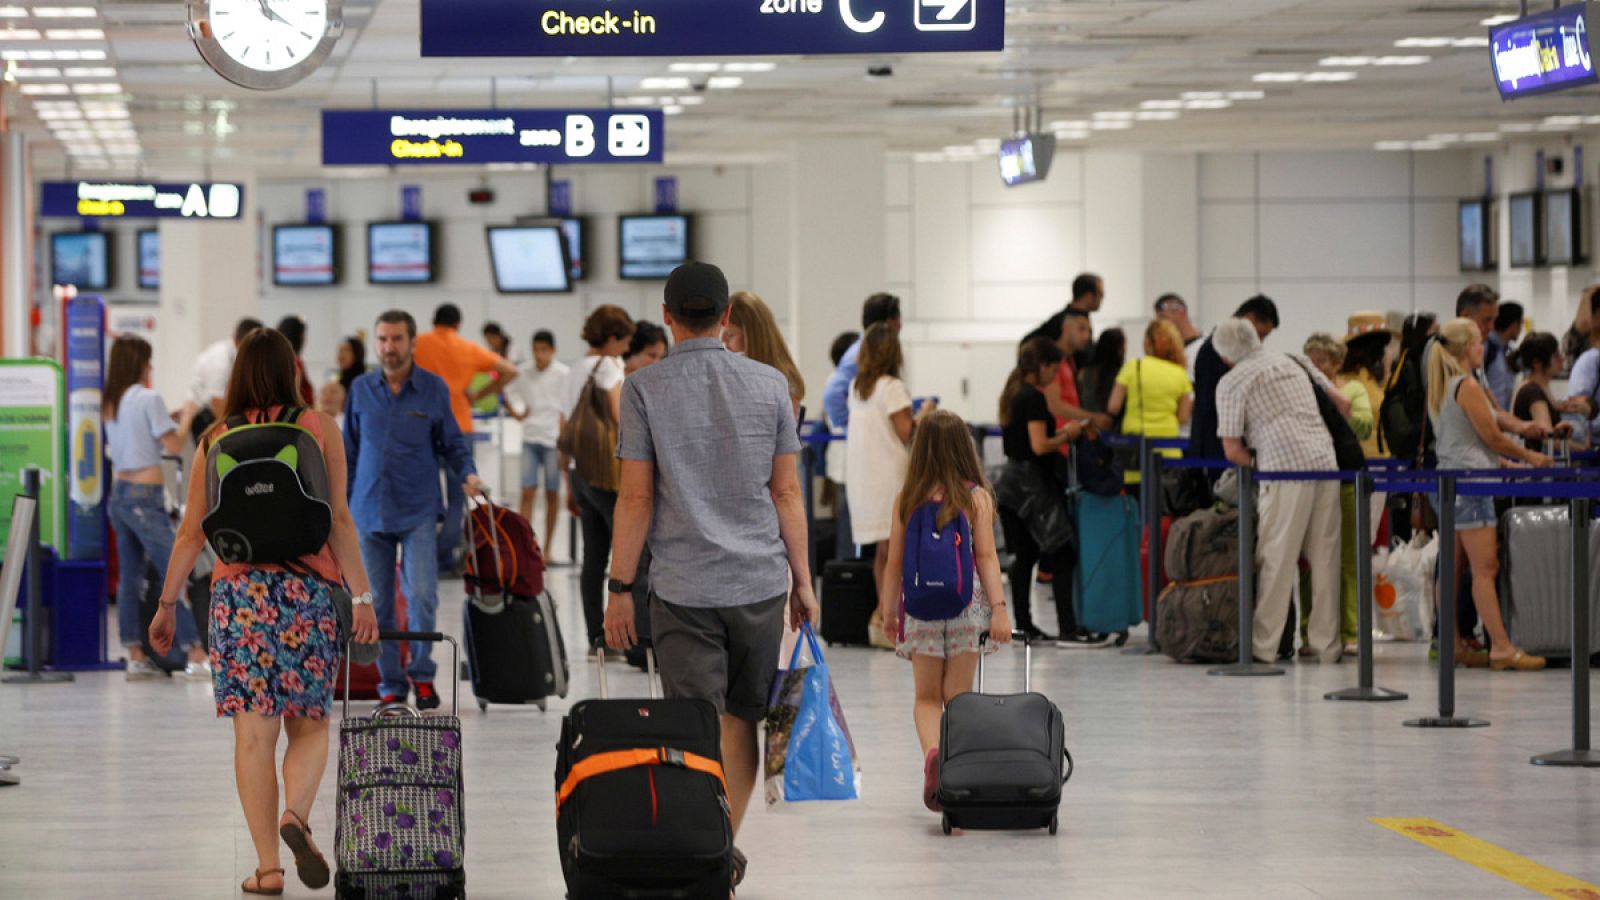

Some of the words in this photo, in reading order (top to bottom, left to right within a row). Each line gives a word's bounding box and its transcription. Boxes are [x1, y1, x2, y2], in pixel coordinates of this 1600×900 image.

[541, 10, 656, 35] Check-in
[760, 0, 823, 14] zone
[838, 0, 885, 33] C
[565, 115, 596, 157] B
[181, 183, 208, 217] A
